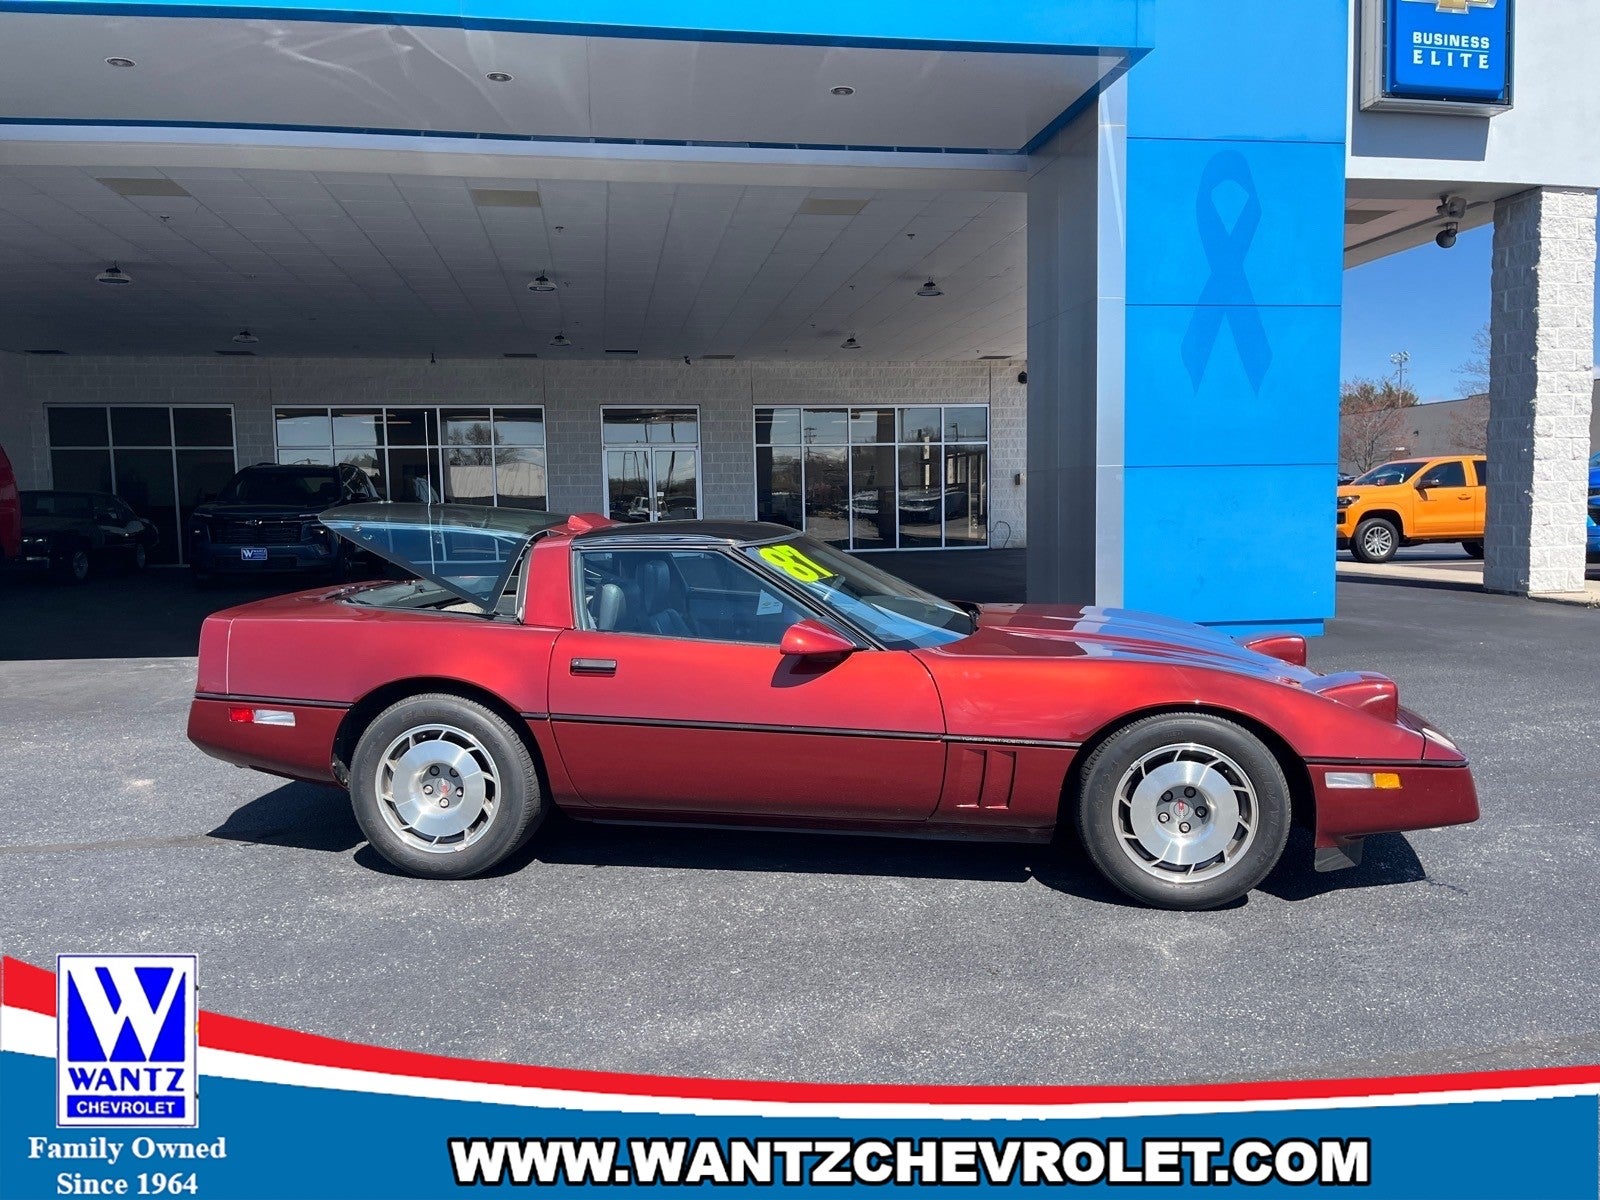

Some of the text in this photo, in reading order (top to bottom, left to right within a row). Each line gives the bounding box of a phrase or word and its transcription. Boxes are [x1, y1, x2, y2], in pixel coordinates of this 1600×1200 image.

[1412, 31, 1490, 49] BUSINESS
[1412, 49, 1490, 69] ELITE
[759, 544, 834, 583] 87
